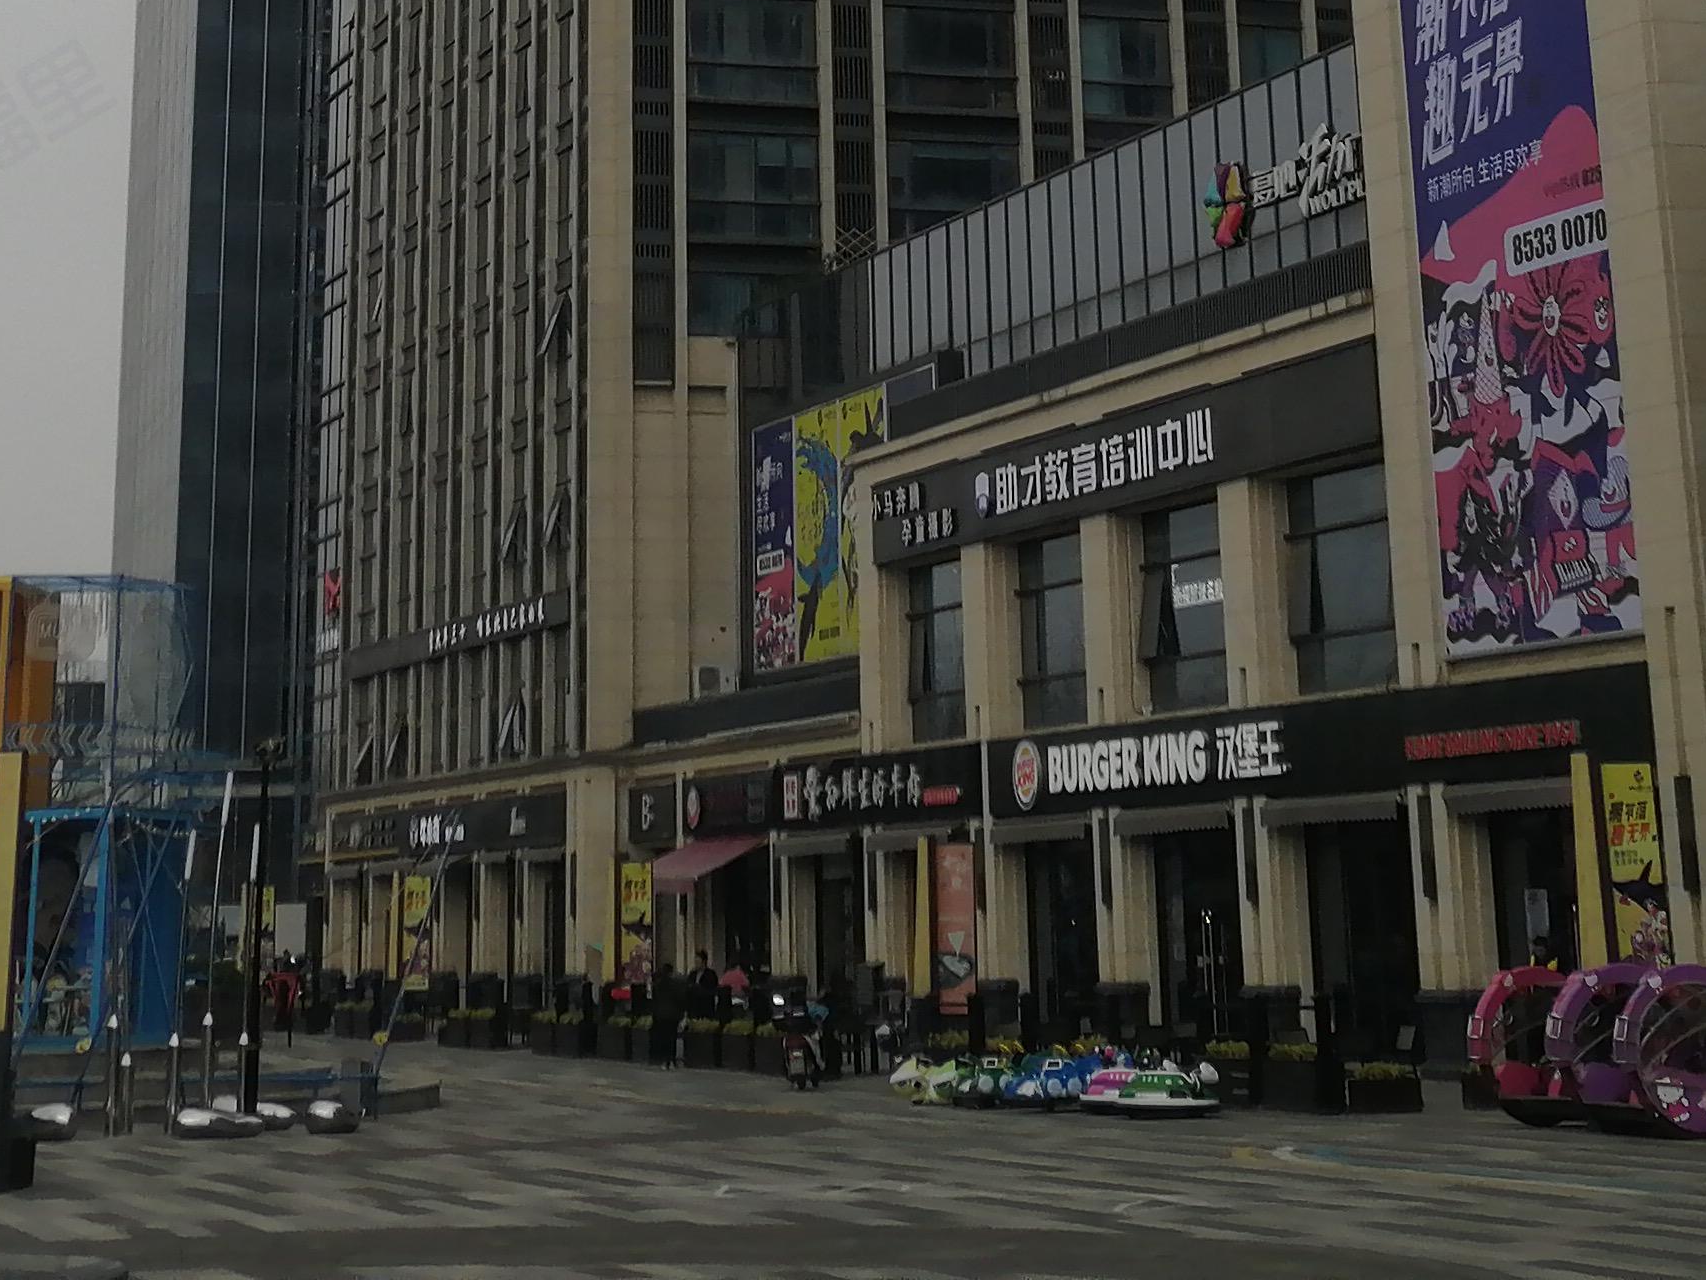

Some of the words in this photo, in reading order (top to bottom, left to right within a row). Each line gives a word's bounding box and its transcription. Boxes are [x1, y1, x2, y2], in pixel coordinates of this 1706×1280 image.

[1422, 17, 1524, 170] 趣无界
[1427, 164, 1476, 203] 新潮所向
[1477, 139, 1543, 184] 生活尽欢享
[1512, 218, 1557, 266] 8533
[1561, 208, 1608, 253] 0070
[995, 407, 1214, 515] 助才教育培训中心
[1047, 737, 1141, 794] BURGER
[1143, 730, 1209, 787] KING
[1215, 721, 1285, 780] 汉堡王
